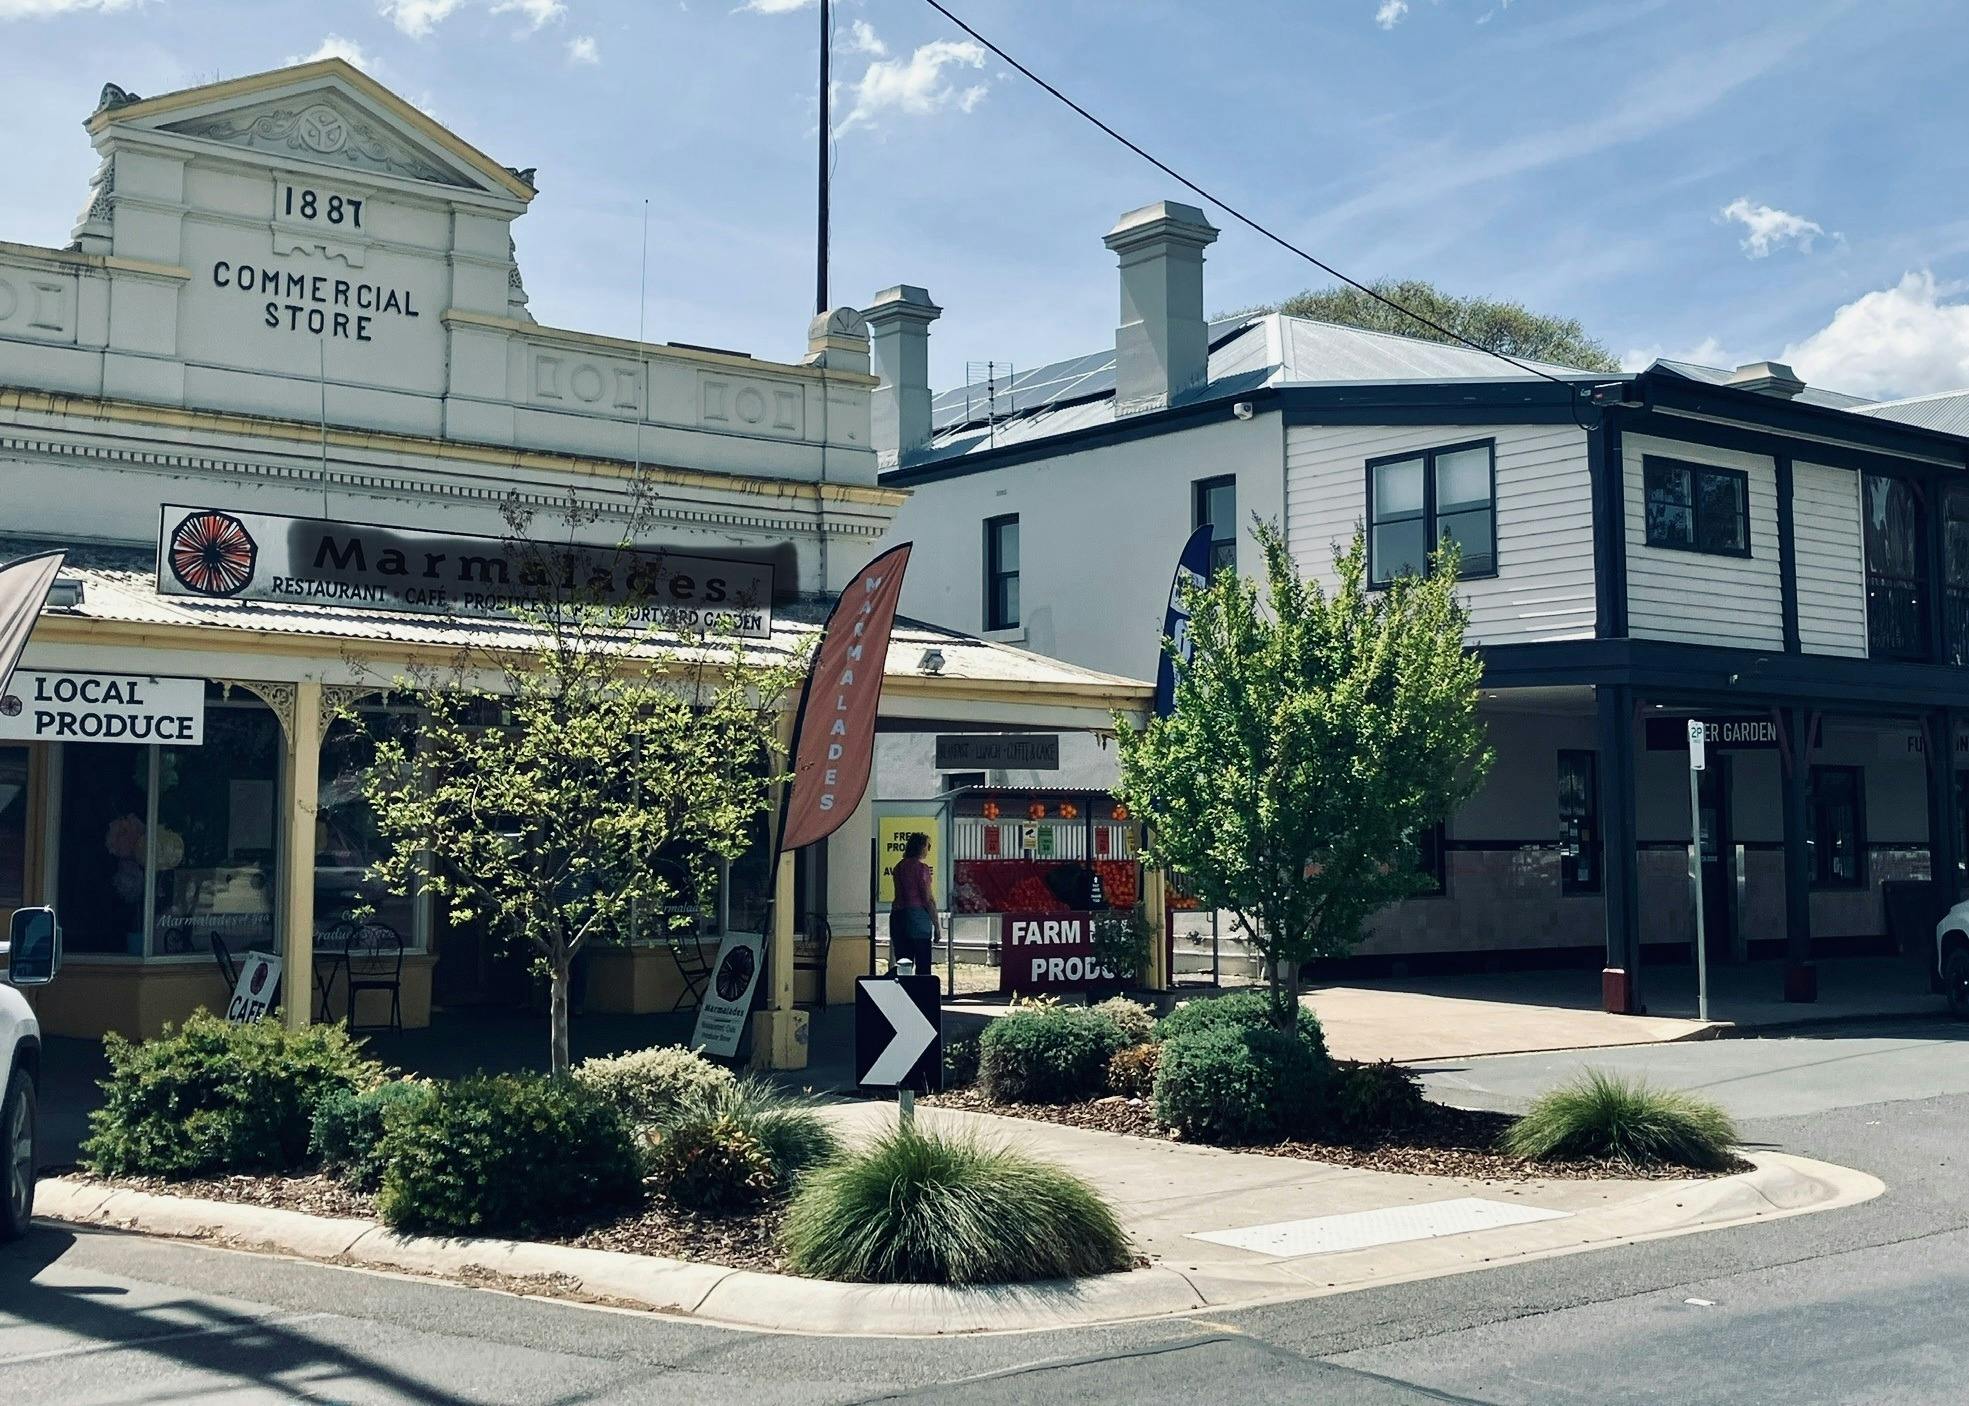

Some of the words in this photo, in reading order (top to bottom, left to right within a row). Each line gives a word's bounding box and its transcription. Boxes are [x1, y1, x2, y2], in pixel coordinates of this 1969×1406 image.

[285, 186, 363, 228] 1887
[213, 261, 420, 317] COMMERCIAL
[265, 302, 372, 341] STORE
[312, 535, 727, 603] Marmalades
[272, 575, 388, 602] RESTAURANT
[405, 584, 447, 606] CAFÉ
[34, 677, 144, 705] LOCAL
[819, 576, 882, 811] MARMALADES
[34, 711, 194, 740] PRODUCE
[1691, 727, 1702, 738] 2P
[1723, 722, 1776, 742] GARDEN
[1011, 920, 1080, 945] FARM
